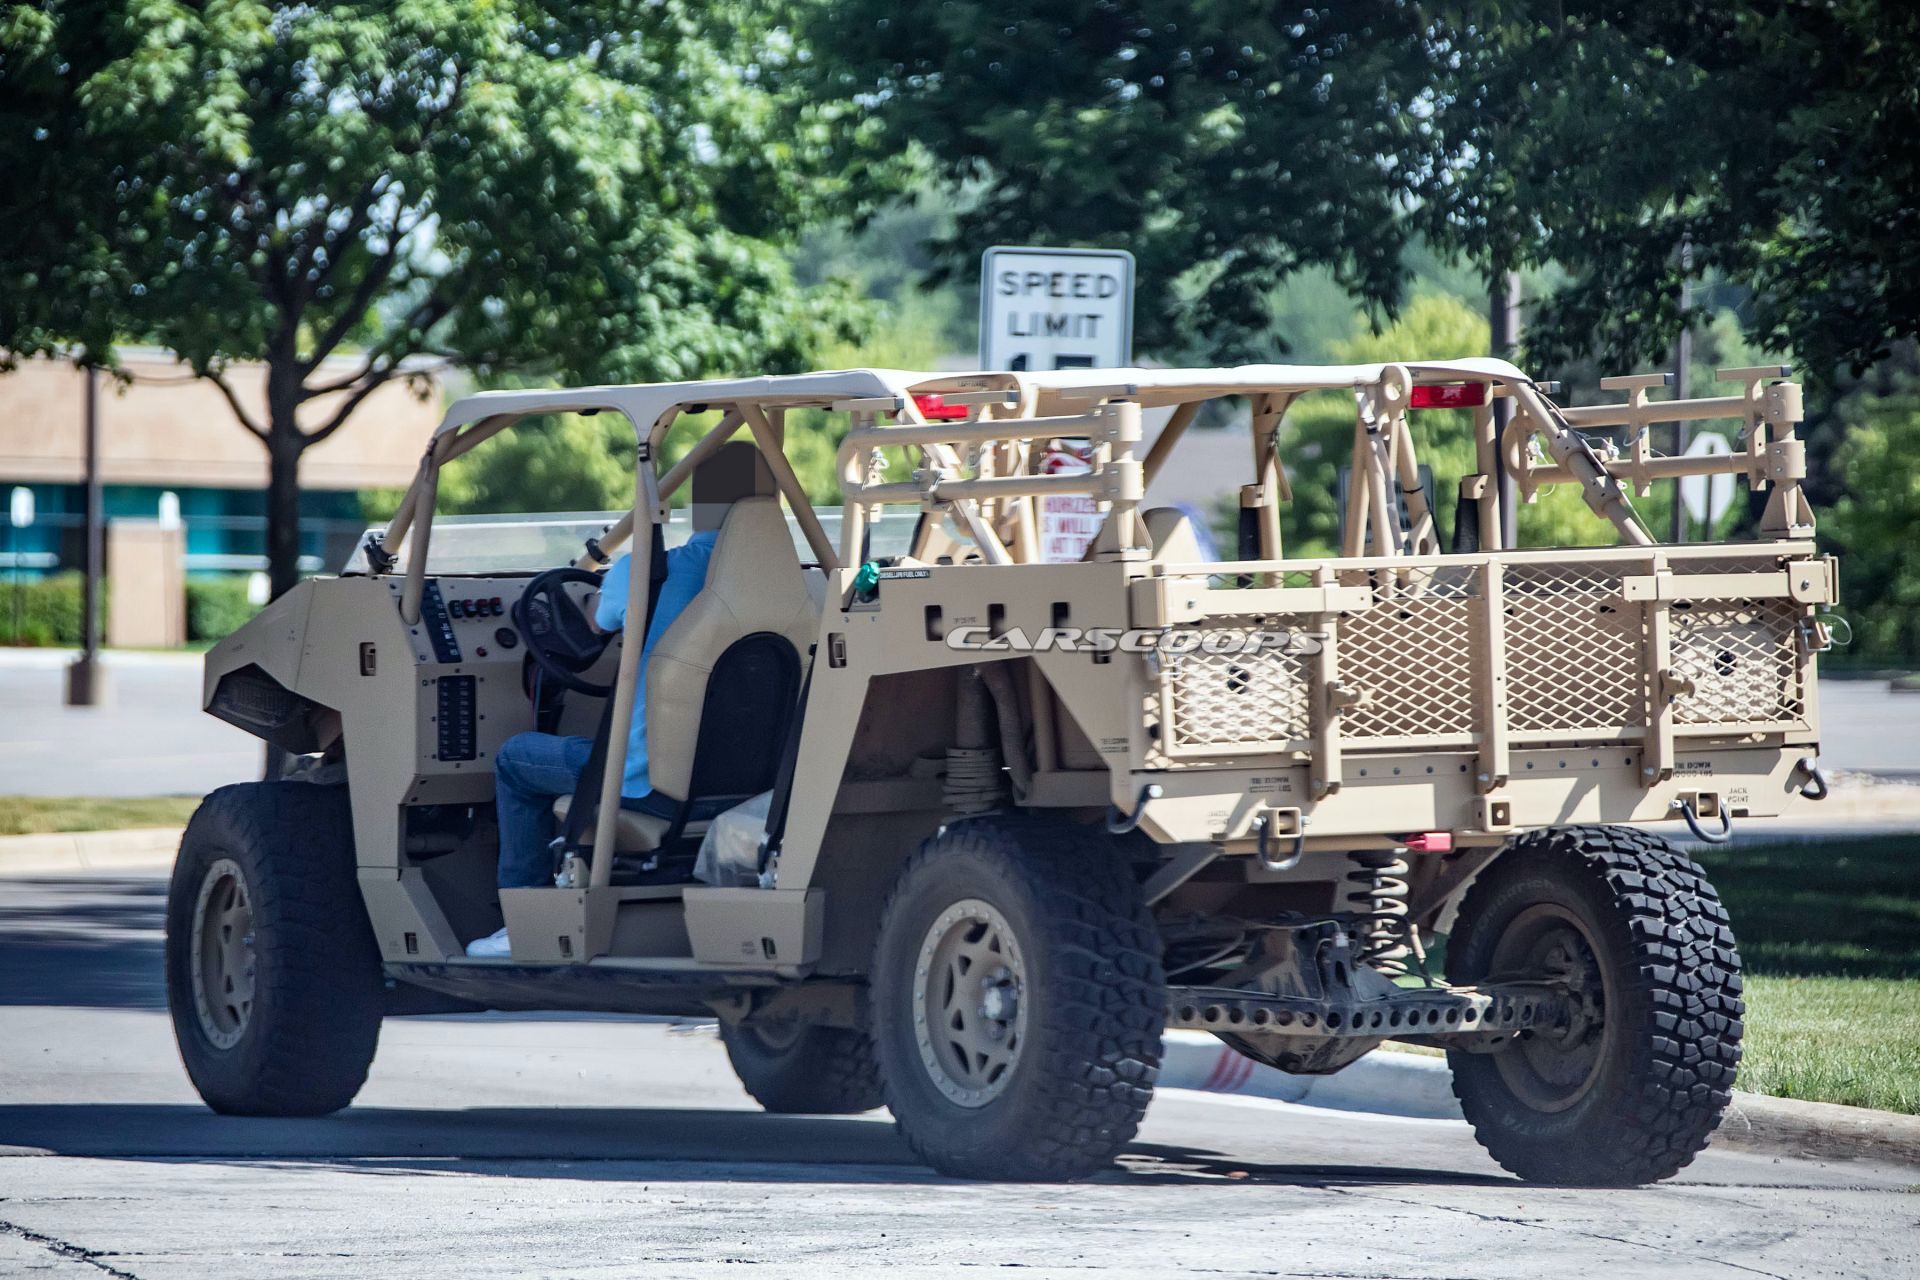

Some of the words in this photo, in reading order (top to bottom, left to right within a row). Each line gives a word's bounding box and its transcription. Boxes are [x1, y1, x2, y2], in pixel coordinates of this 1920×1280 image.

[998, 271, 1118, 299] SPEED
[1008, 311, 1103, 338] LIMIT
[1727, 795, 1749, 803] POINT
